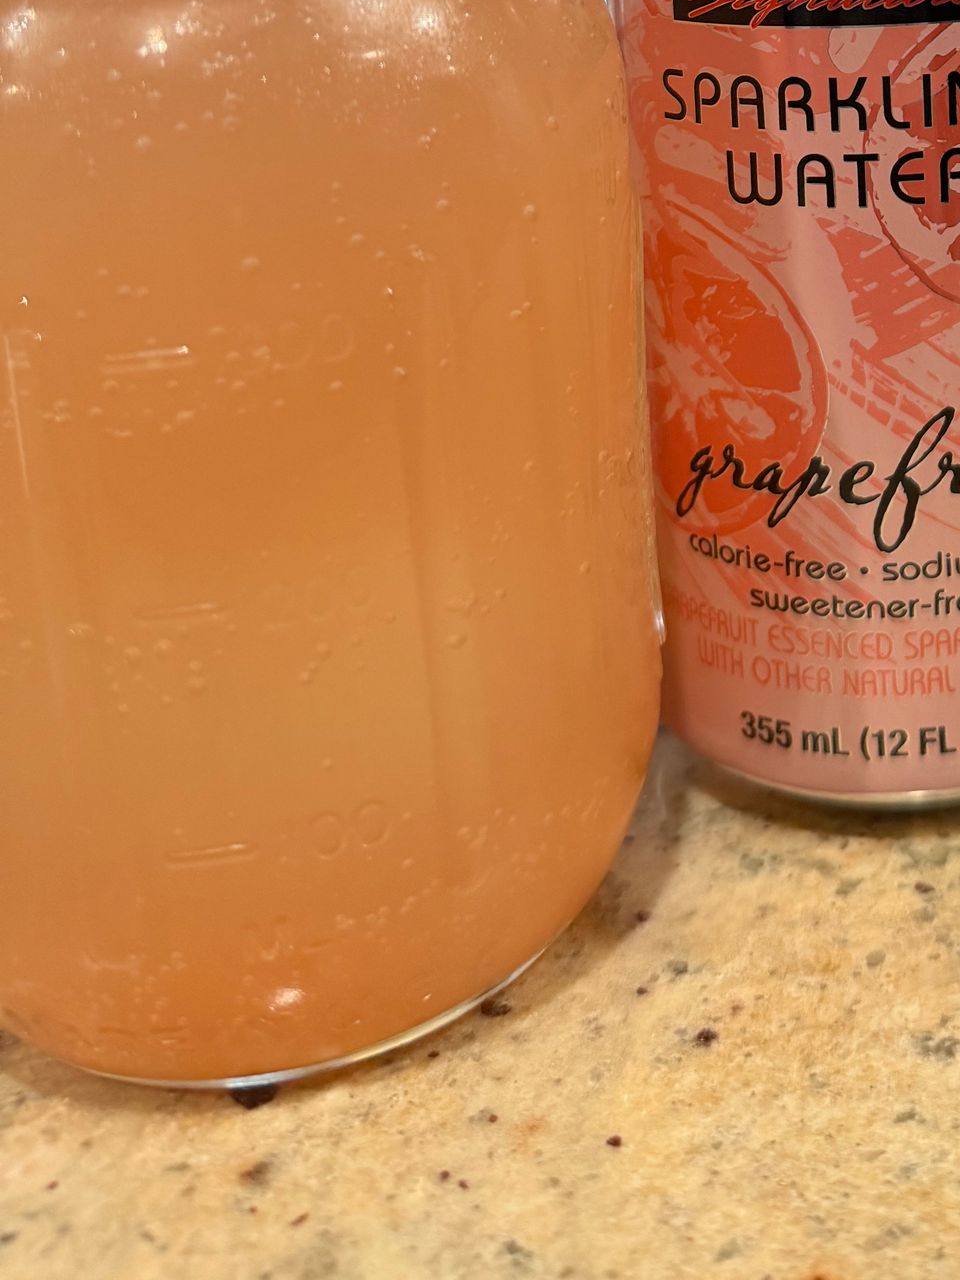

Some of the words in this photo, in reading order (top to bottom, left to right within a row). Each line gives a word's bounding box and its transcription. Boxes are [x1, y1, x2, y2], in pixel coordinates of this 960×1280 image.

[689, 532, 847, 581] calorie-free
[698, 634, 744, 678] WITH
[752, 655, 832, 695] OTHER
[842, 667, 956, 697] NATURAL
[767, 623, 894, 663] ESSENCED
[740, 711, 793, 749] 355
[801, 727, 850, 757] mL
[860, 726, 909, 761] (12
[918, 725, 957, 756] FL
